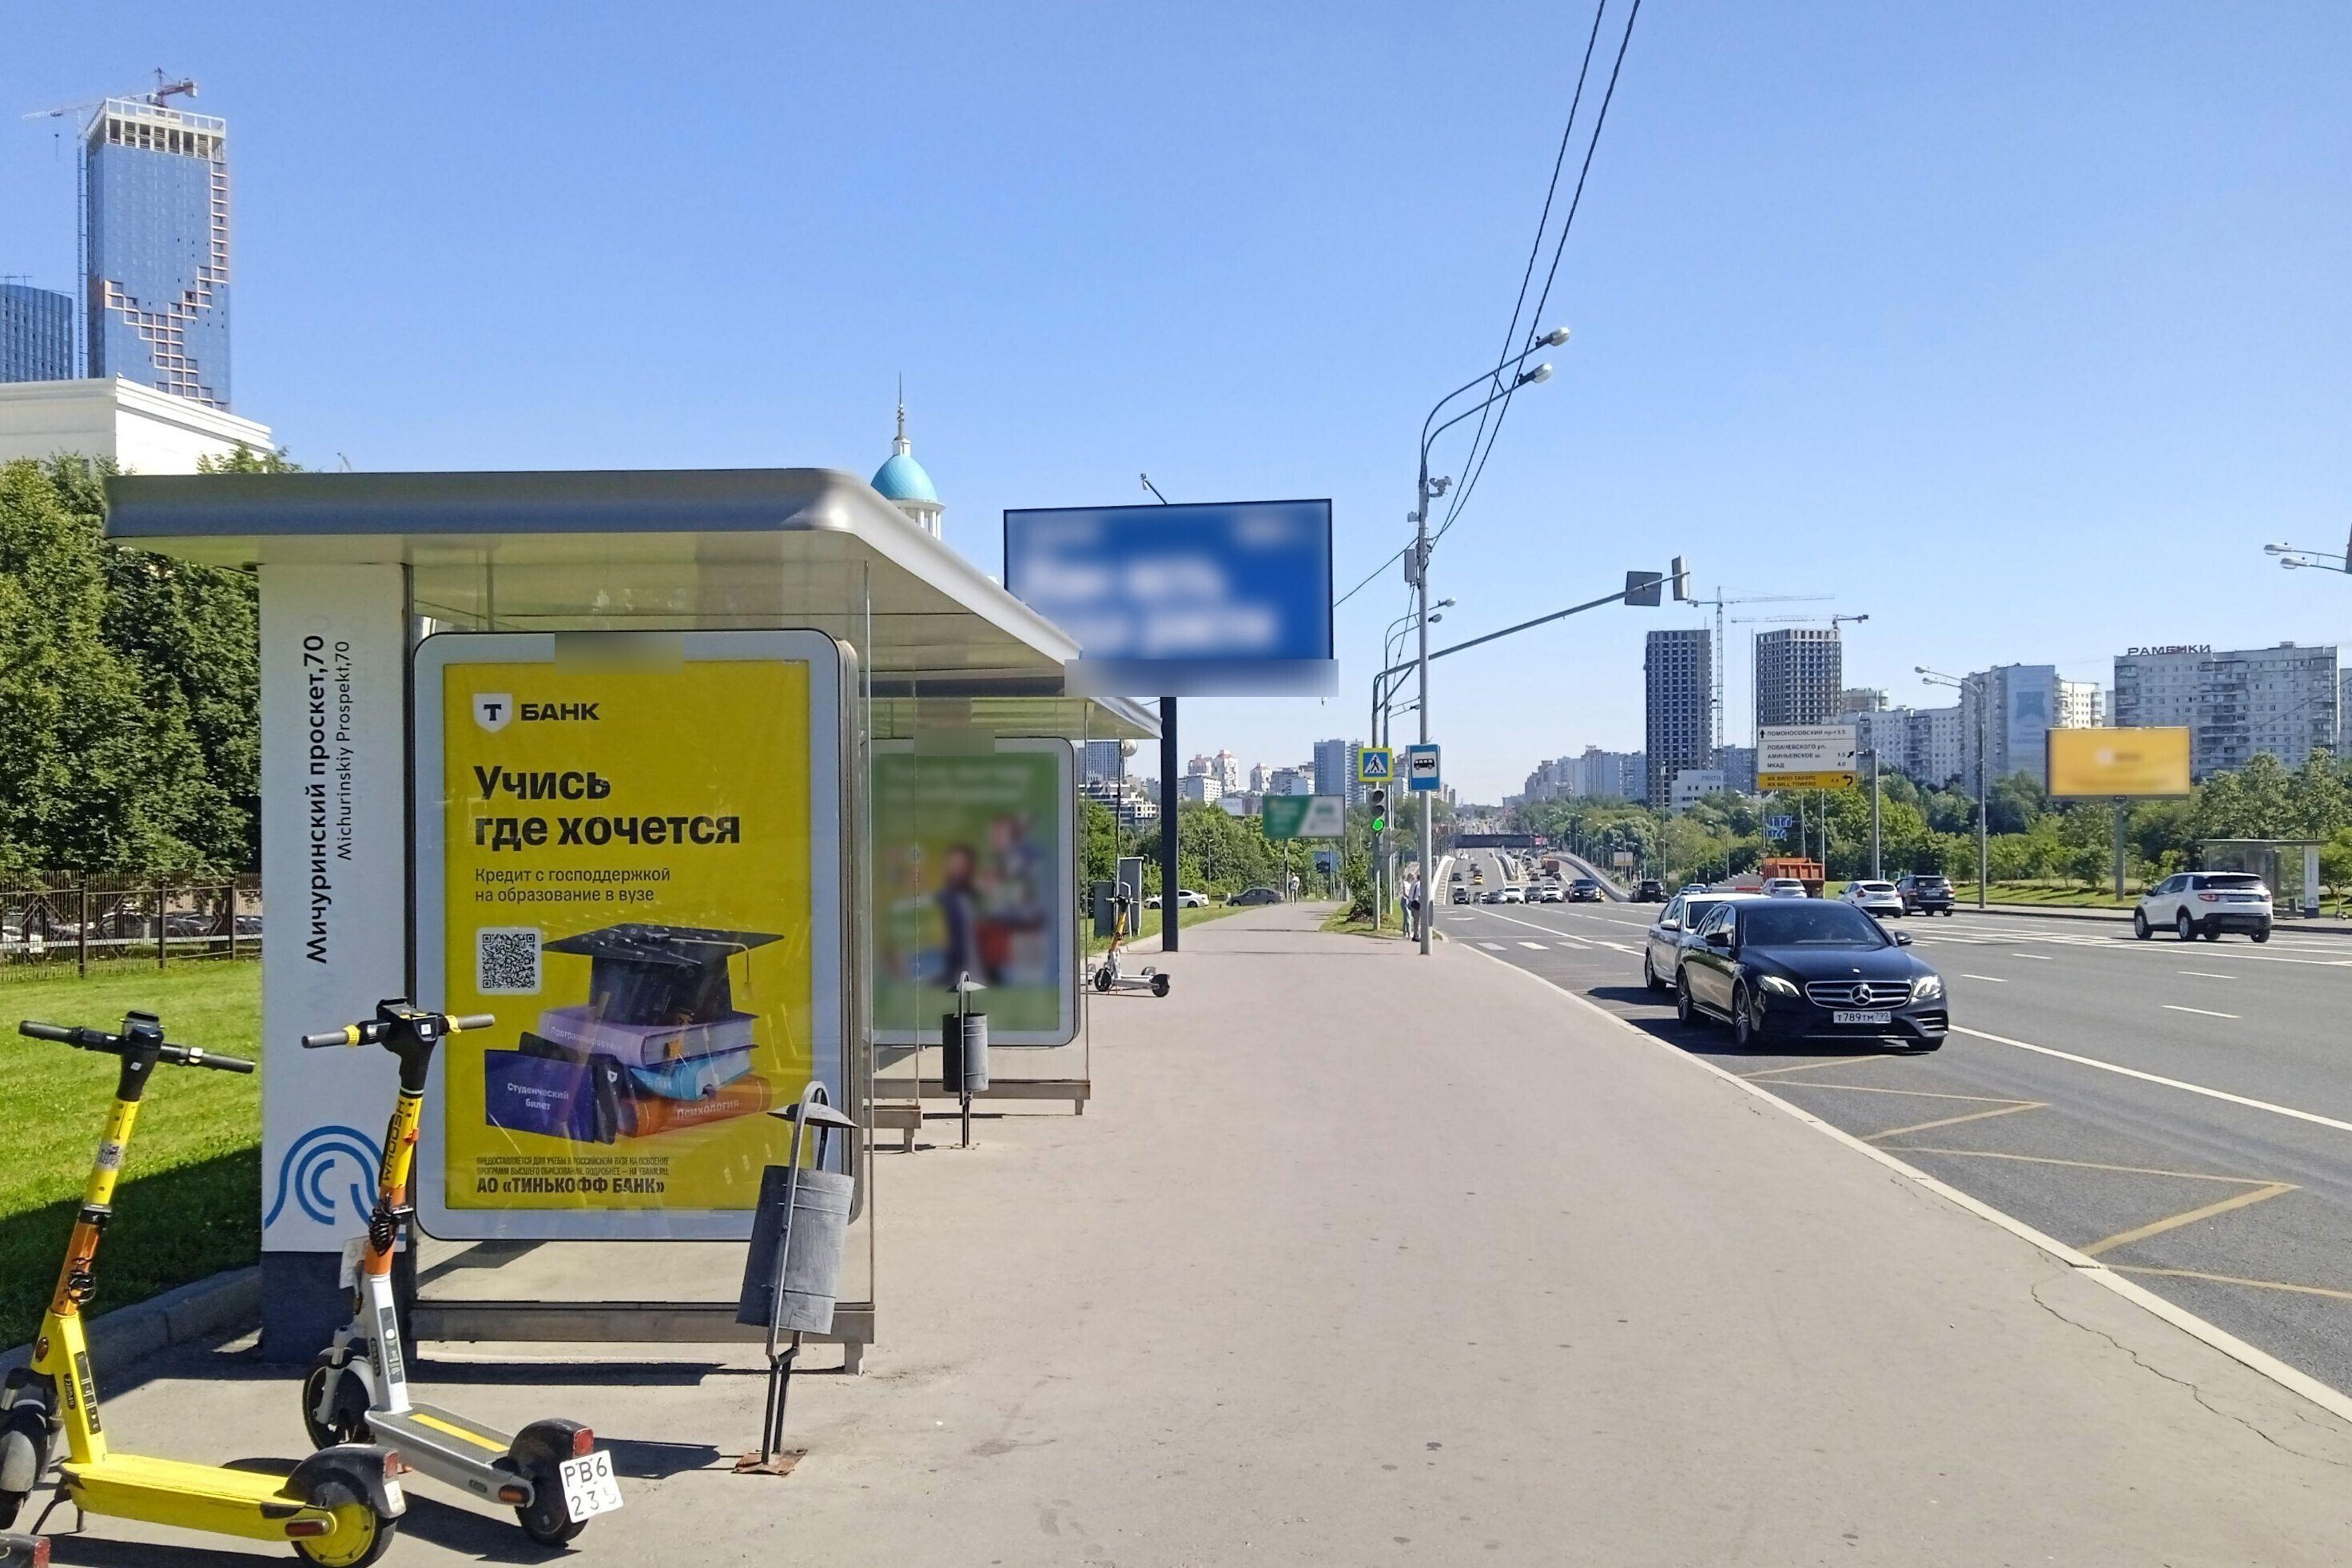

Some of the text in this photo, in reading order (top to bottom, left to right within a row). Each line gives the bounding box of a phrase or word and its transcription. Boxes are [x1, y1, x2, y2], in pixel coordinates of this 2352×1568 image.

[2127, 644, 2211, 655] РАМЕНКИ
[521, 703, 600, 721] БАНК
[335, 642, 354, 860] Michurinskiy Prospekt,70
[473, 766, 611, 800] Учись
[303, 635, 332, 964] Мичуринский проскет,70
[476, 815, 740, 851] где хочется
[476, 868, 671, 884] Кредит с господдержкой
[476, 888, 654, 904] на образование в вузе
[507, 1082, 569, 1100] Студенческий
[525, 1098, 551, 1110] билет
[676, 1099, 739, 1119] Психология
[476, 1177, 665, 1193] АО «ТИНЬКОФФ БАНК»
